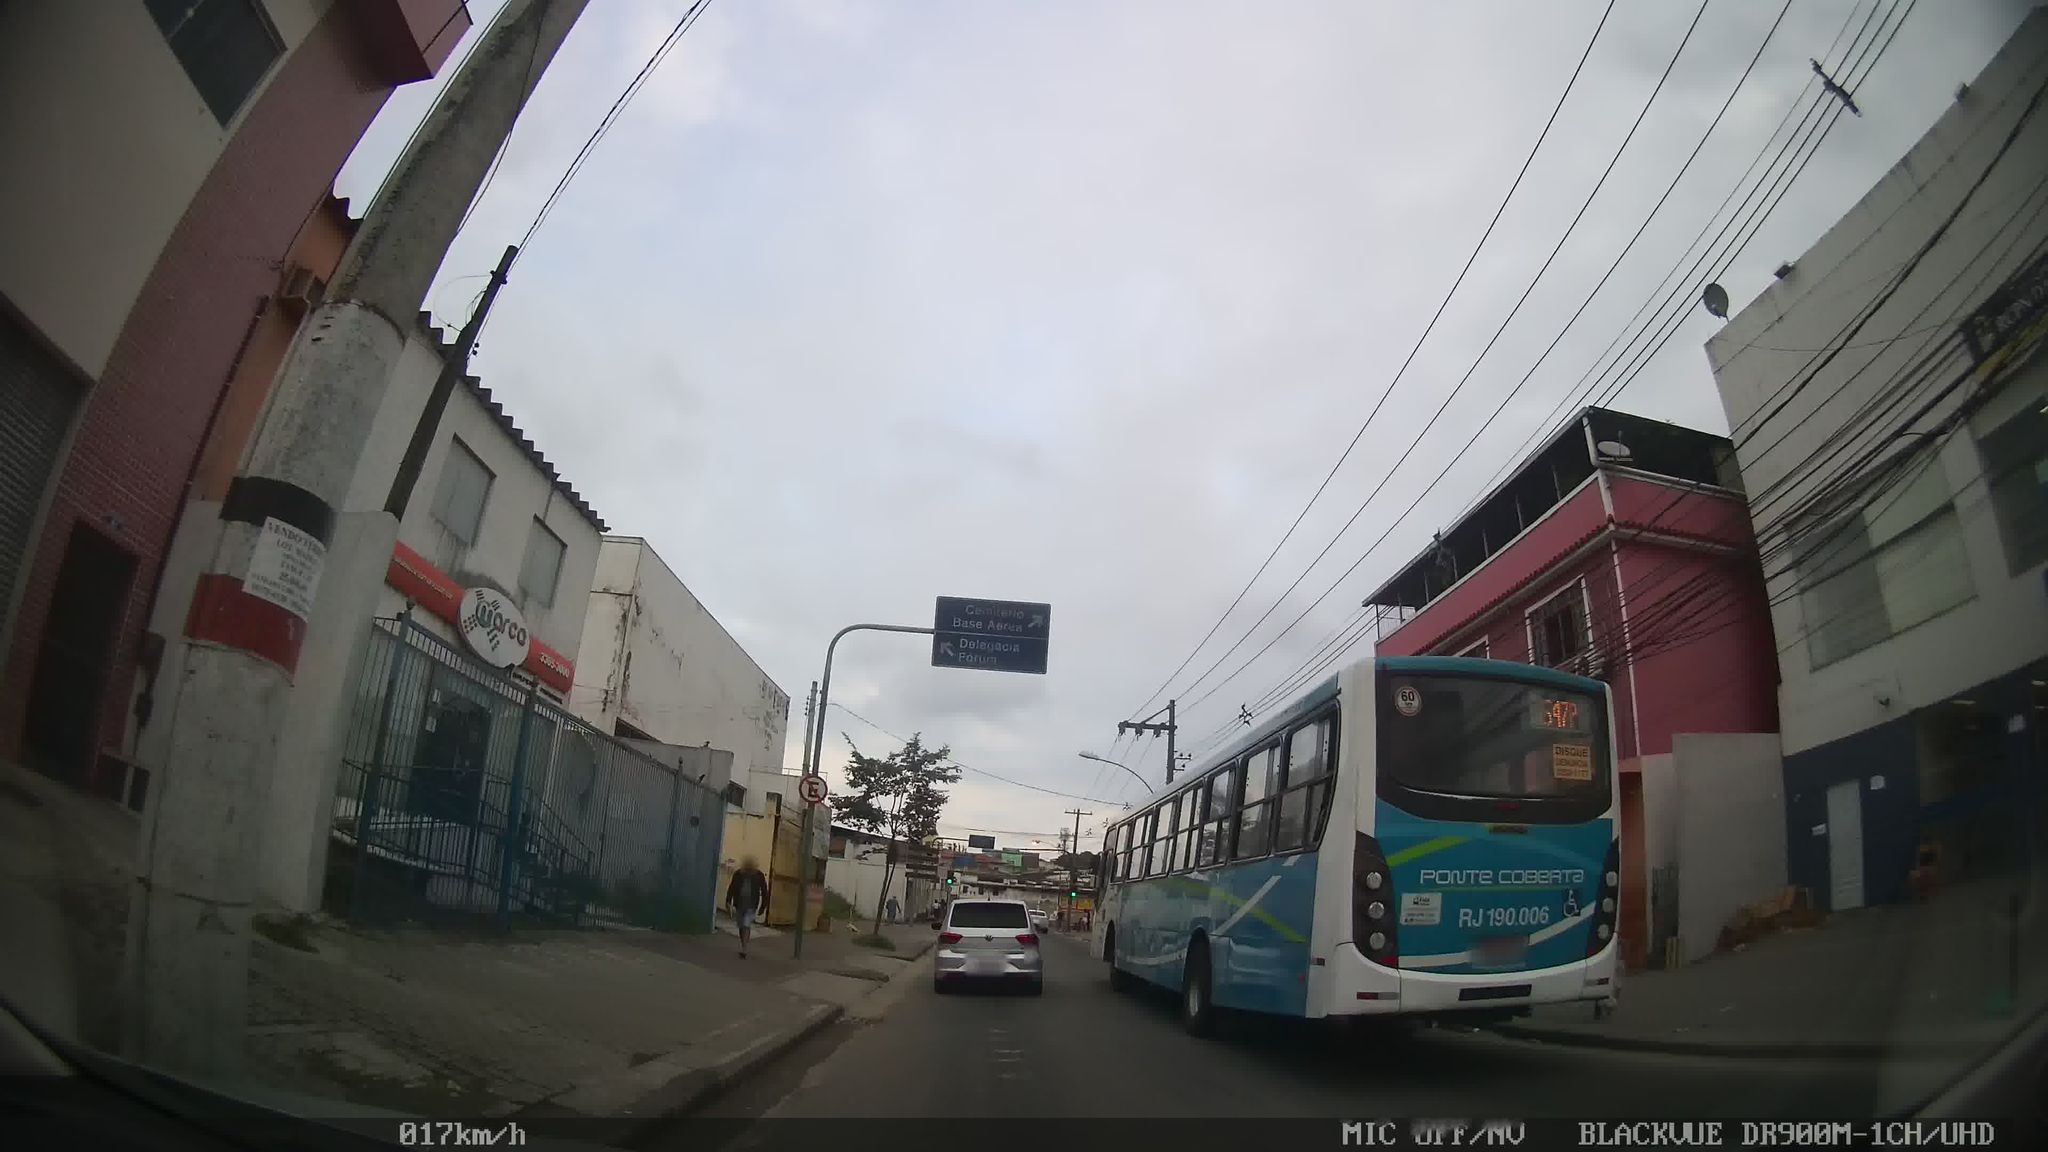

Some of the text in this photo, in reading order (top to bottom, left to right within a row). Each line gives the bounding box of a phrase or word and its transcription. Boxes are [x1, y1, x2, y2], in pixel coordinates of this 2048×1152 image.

[953, 617, 983, 629] Base
[960, 638, 1020, 653] Delegacia
[1401, 691, 1415, 702] 60
[1555, 746, 1589, 758] DISQUE
[1419, 869, 1585, 885] PONTE COBERTA
[1459, 905, 1550, 929] RJ 190.006
